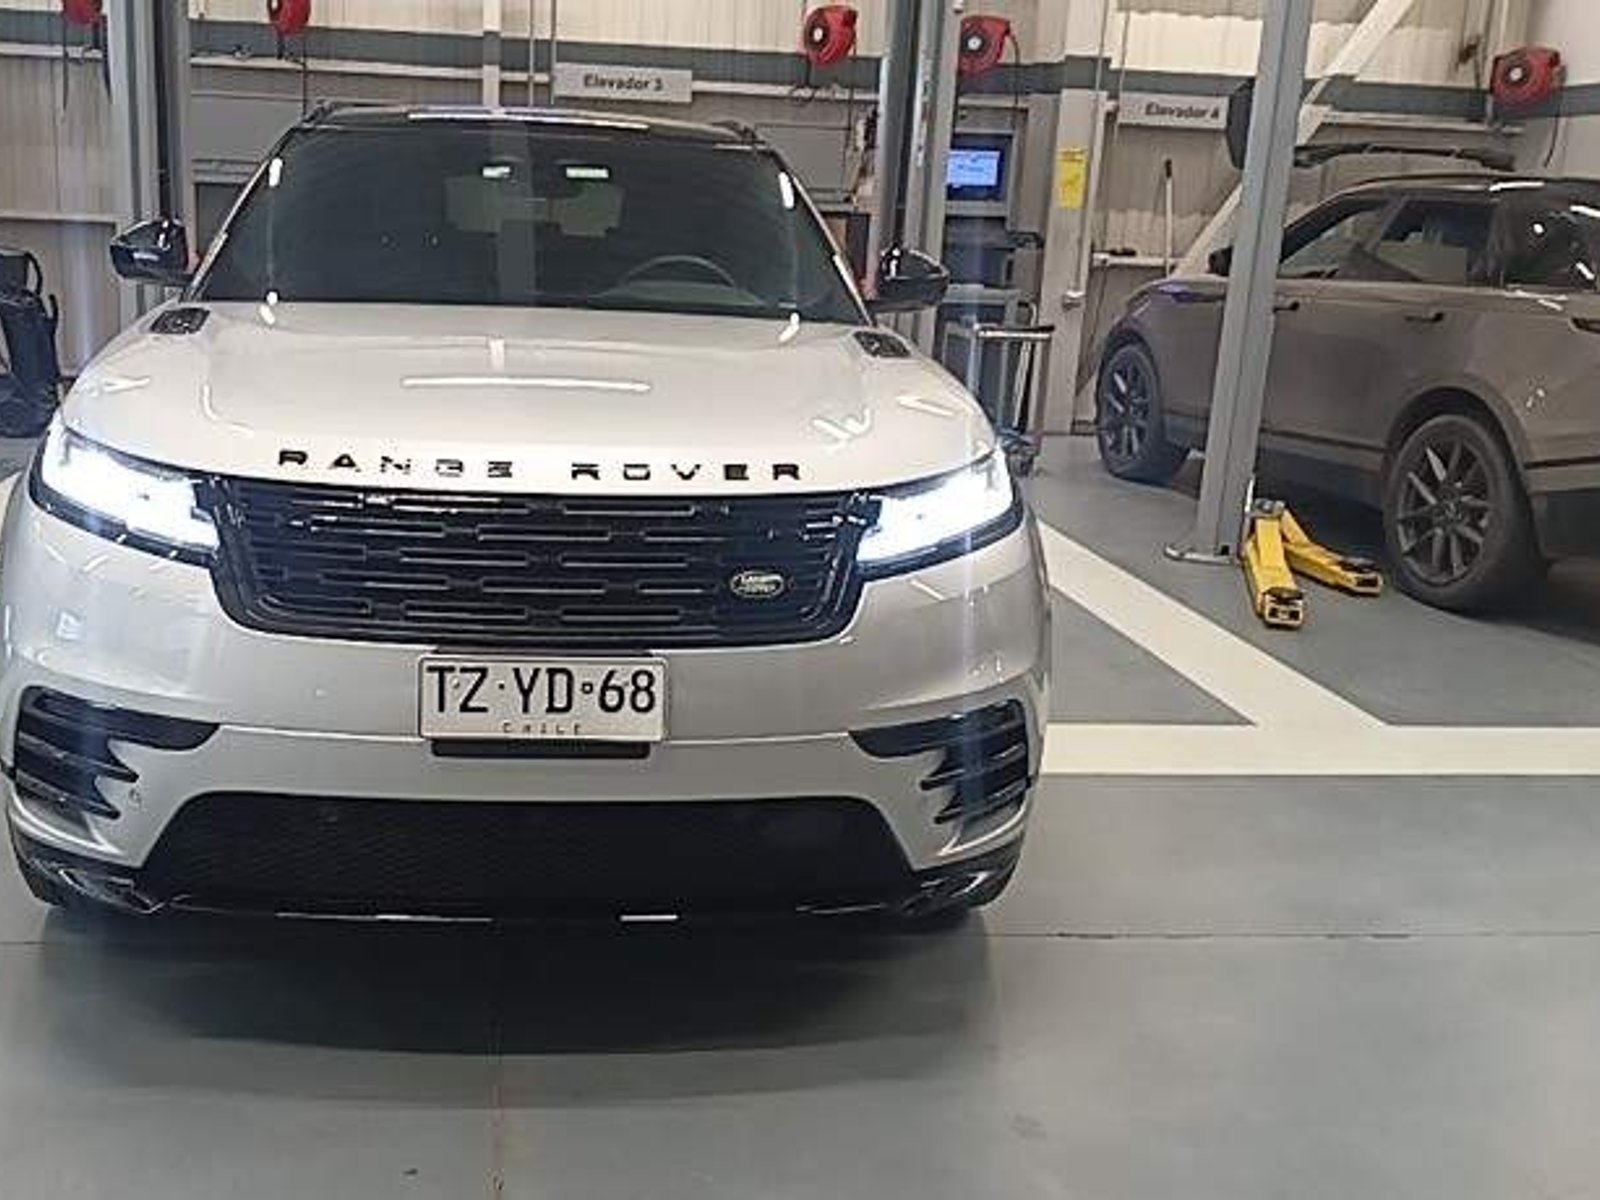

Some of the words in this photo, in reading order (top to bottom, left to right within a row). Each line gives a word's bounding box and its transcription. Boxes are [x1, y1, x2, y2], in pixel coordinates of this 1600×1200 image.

[584, 73, 649, 90] Elevador
[1145, 101, 1208, 118] Elevador
[279, 449, 513, 478] RANGE
[571, 463, 801, 481] ROVER
[503, 722, 580, 735] CHILE
